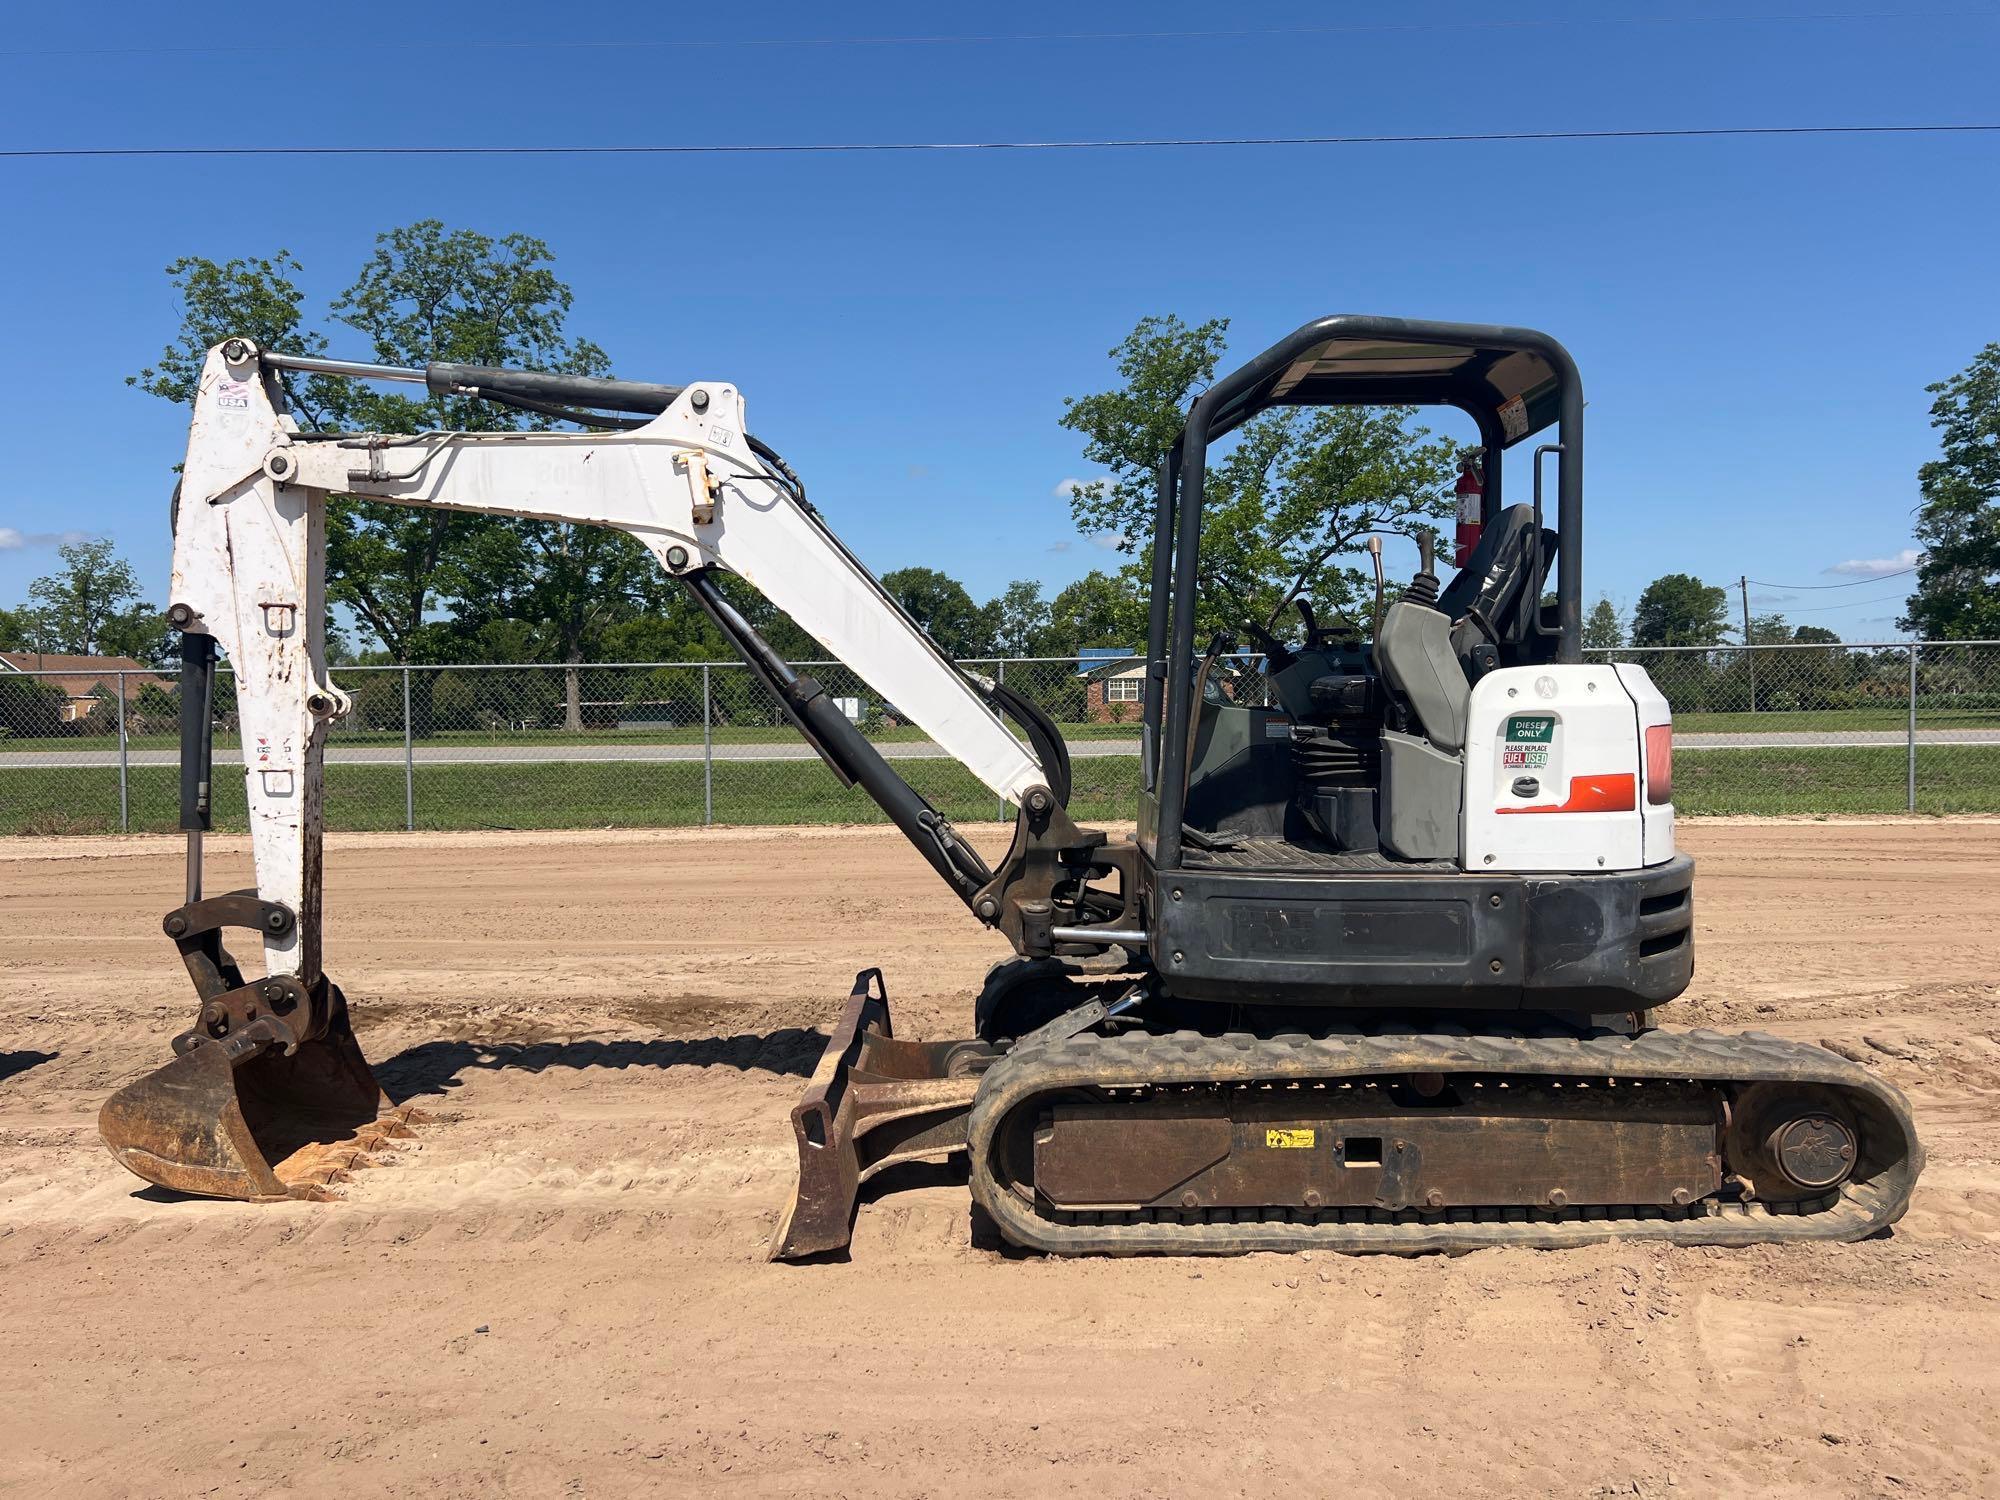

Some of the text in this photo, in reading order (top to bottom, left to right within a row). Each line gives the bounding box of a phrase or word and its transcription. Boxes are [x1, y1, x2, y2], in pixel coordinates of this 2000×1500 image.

[219, 398, 247, 407] USA
[1504, 753, 1547, 764] FUEL USED
